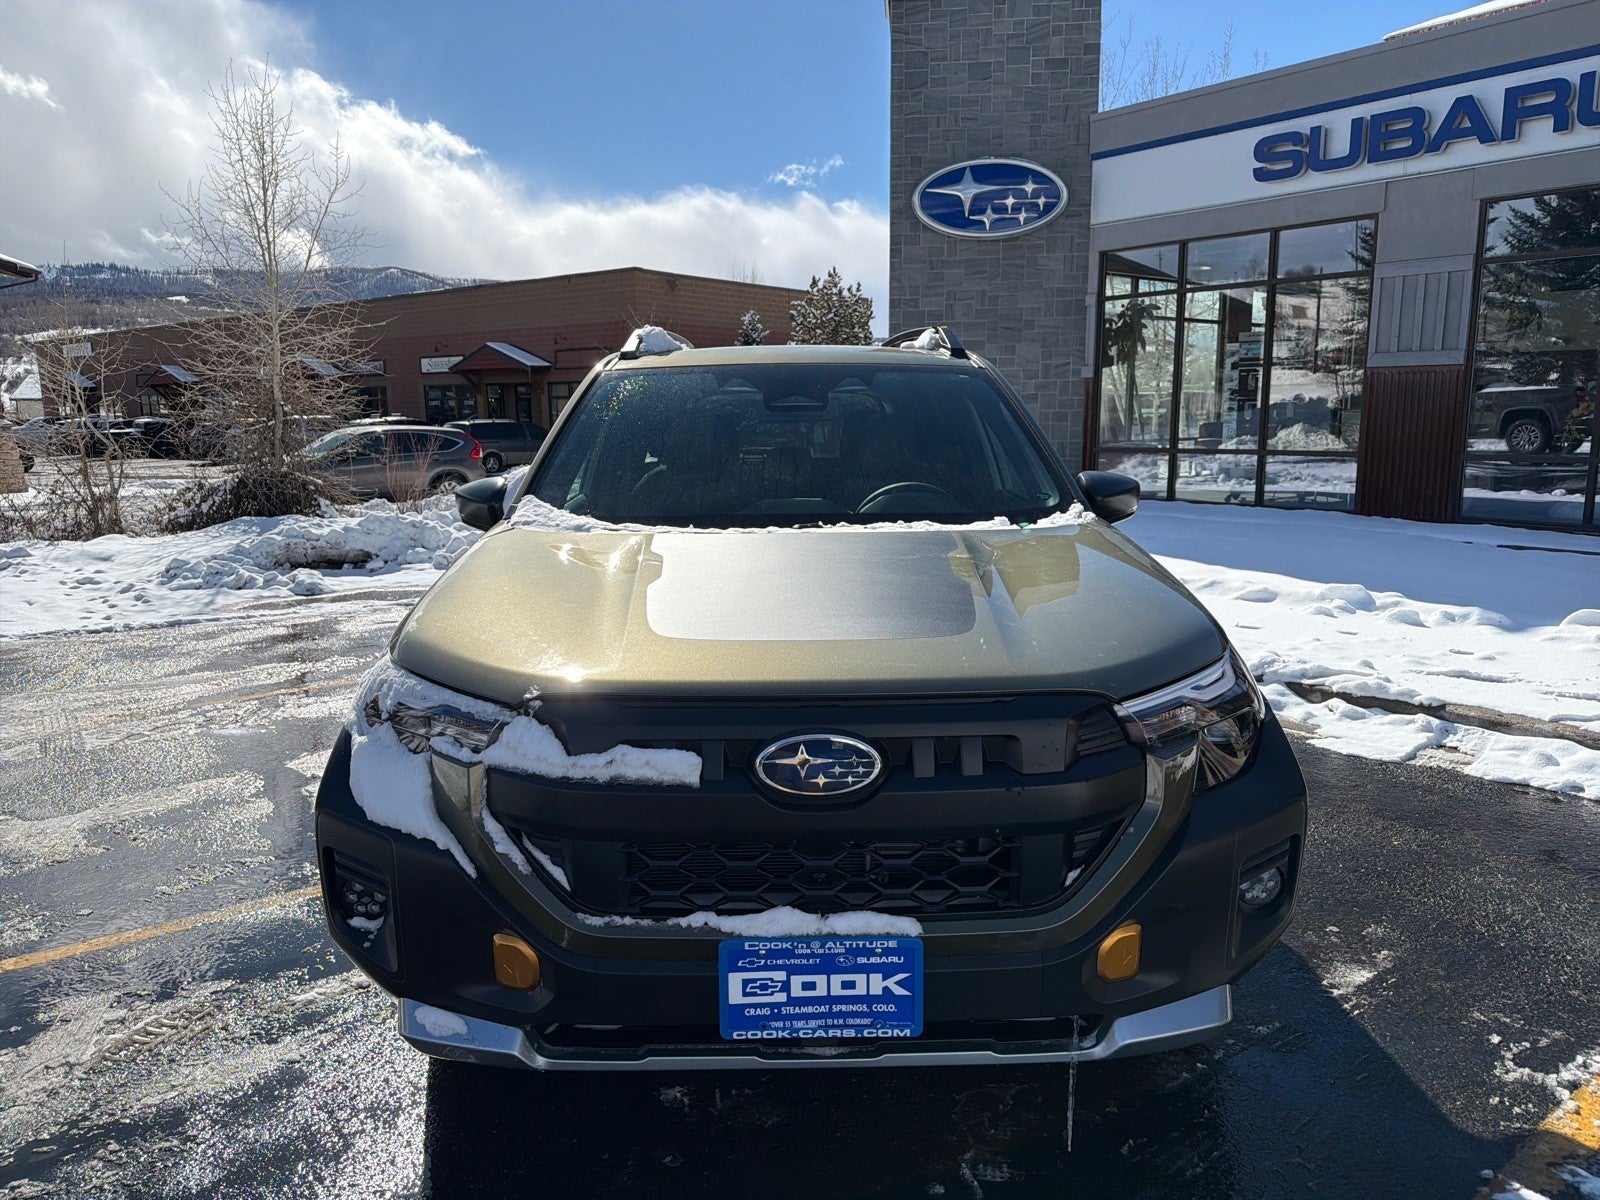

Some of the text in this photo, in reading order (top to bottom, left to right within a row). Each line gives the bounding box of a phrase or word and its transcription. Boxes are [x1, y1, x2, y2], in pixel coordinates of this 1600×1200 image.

[810, 940, 821, 949] @
[824, 940, 898, 949] ALTITUDE
[856, 956, 904, 964] SUBARU
[728, 970, 913, 1005] COOK
[744, 1003, 898, 1016] CRAIG STEAMBOAT SPRINGS, COLO.
[792, 1020, 807, 1028] YEARS
[807, 1019, 826, 1027] SERVICE
[826, 1018, 833, 1026] TO
[732, 1028, 911, 1040] COOK-CARS.COM
